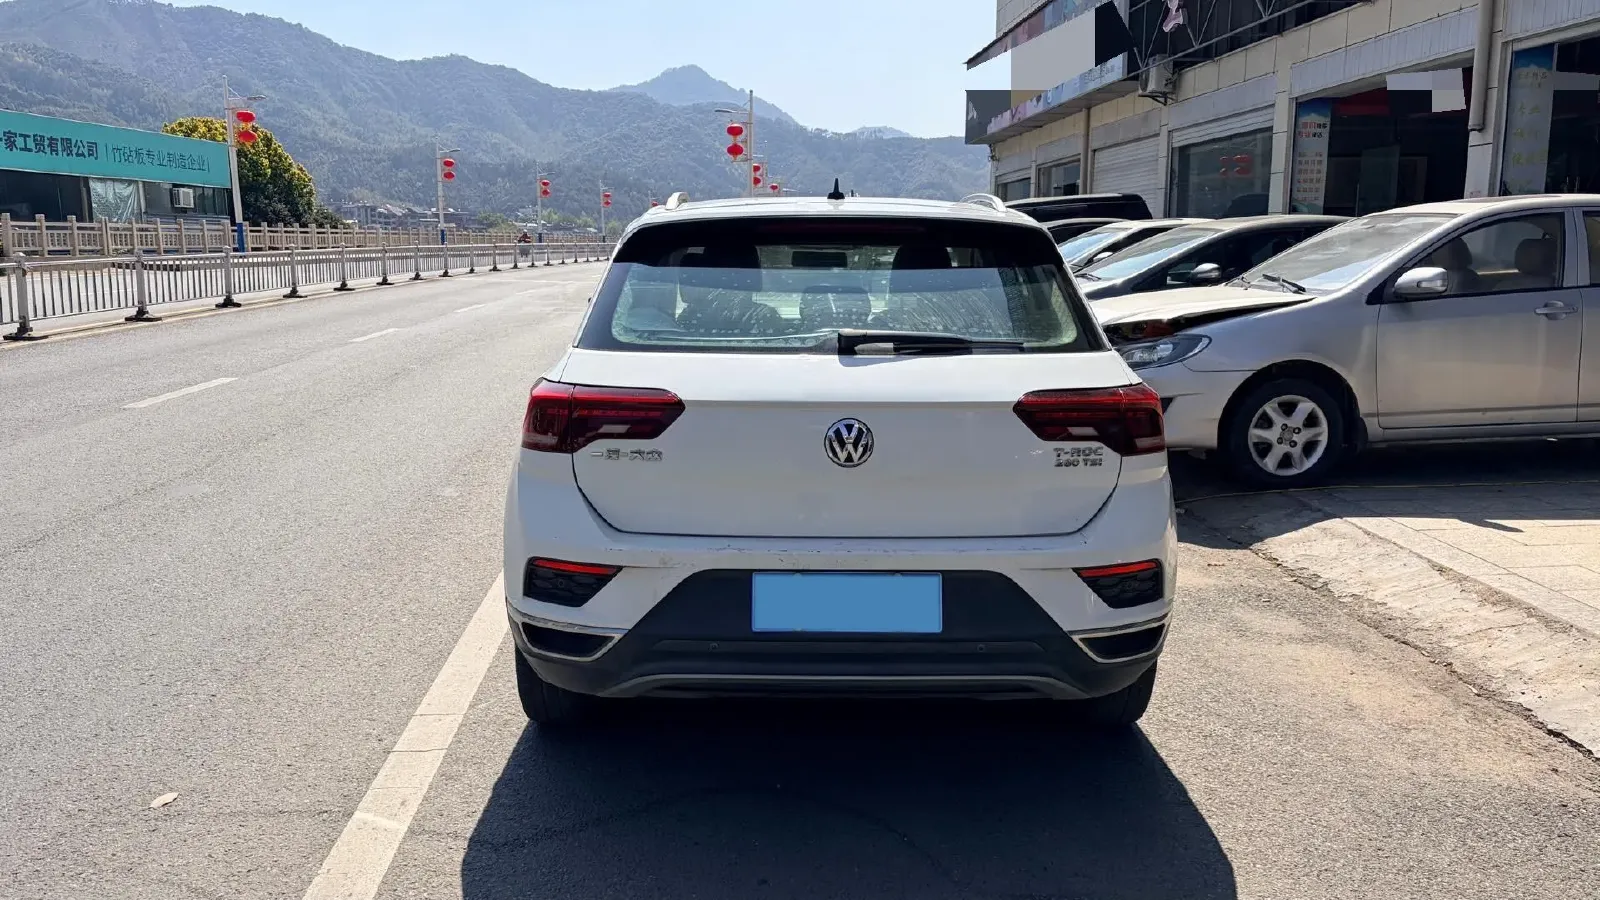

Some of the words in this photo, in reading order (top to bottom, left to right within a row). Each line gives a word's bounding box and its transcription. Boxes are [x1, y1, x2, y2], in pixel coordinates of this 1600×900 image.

[0, 130, 99, 160] 家工贸有限公司
[1053, 447, 1103, 457] T-ROC
